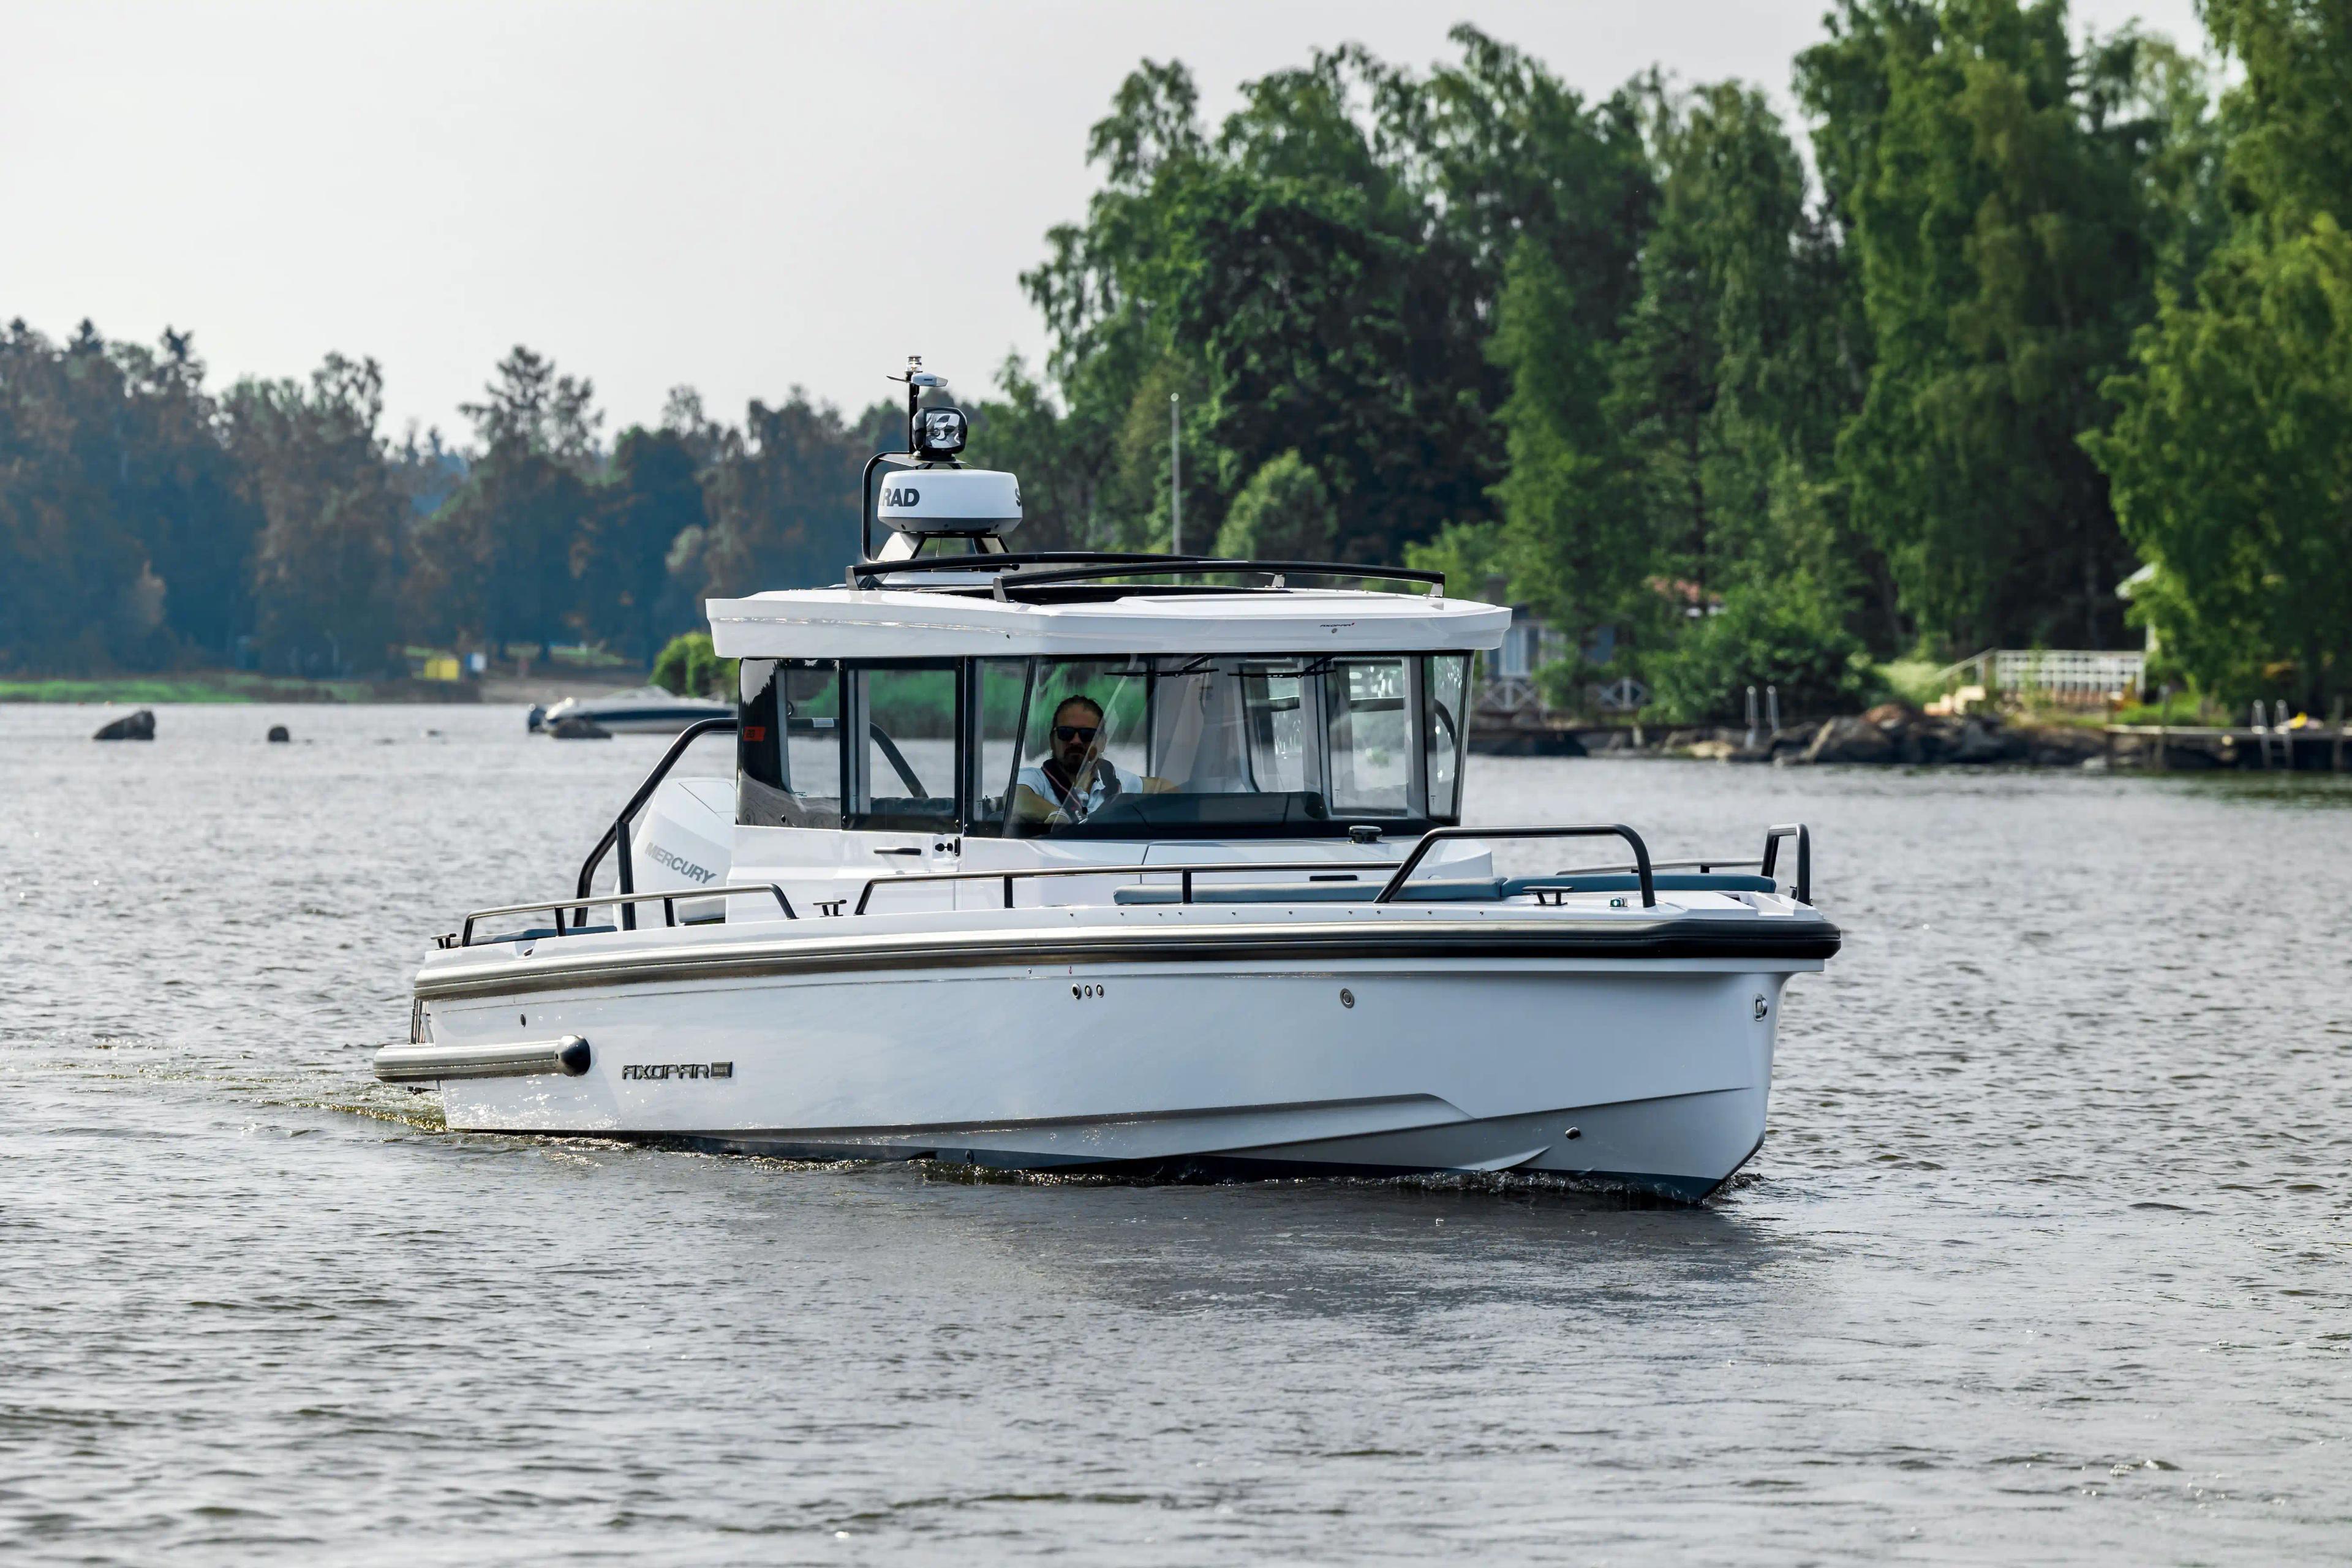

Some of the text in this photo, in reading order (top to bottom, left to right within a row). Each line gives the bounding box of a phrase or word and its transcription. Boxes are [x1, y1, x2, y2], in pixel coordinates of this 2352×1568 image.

[880, 488, 920, 507] RAD
[644, 842, 717, 884] MERCURY
[622, 1064, 710, 1080] AXOPAR
